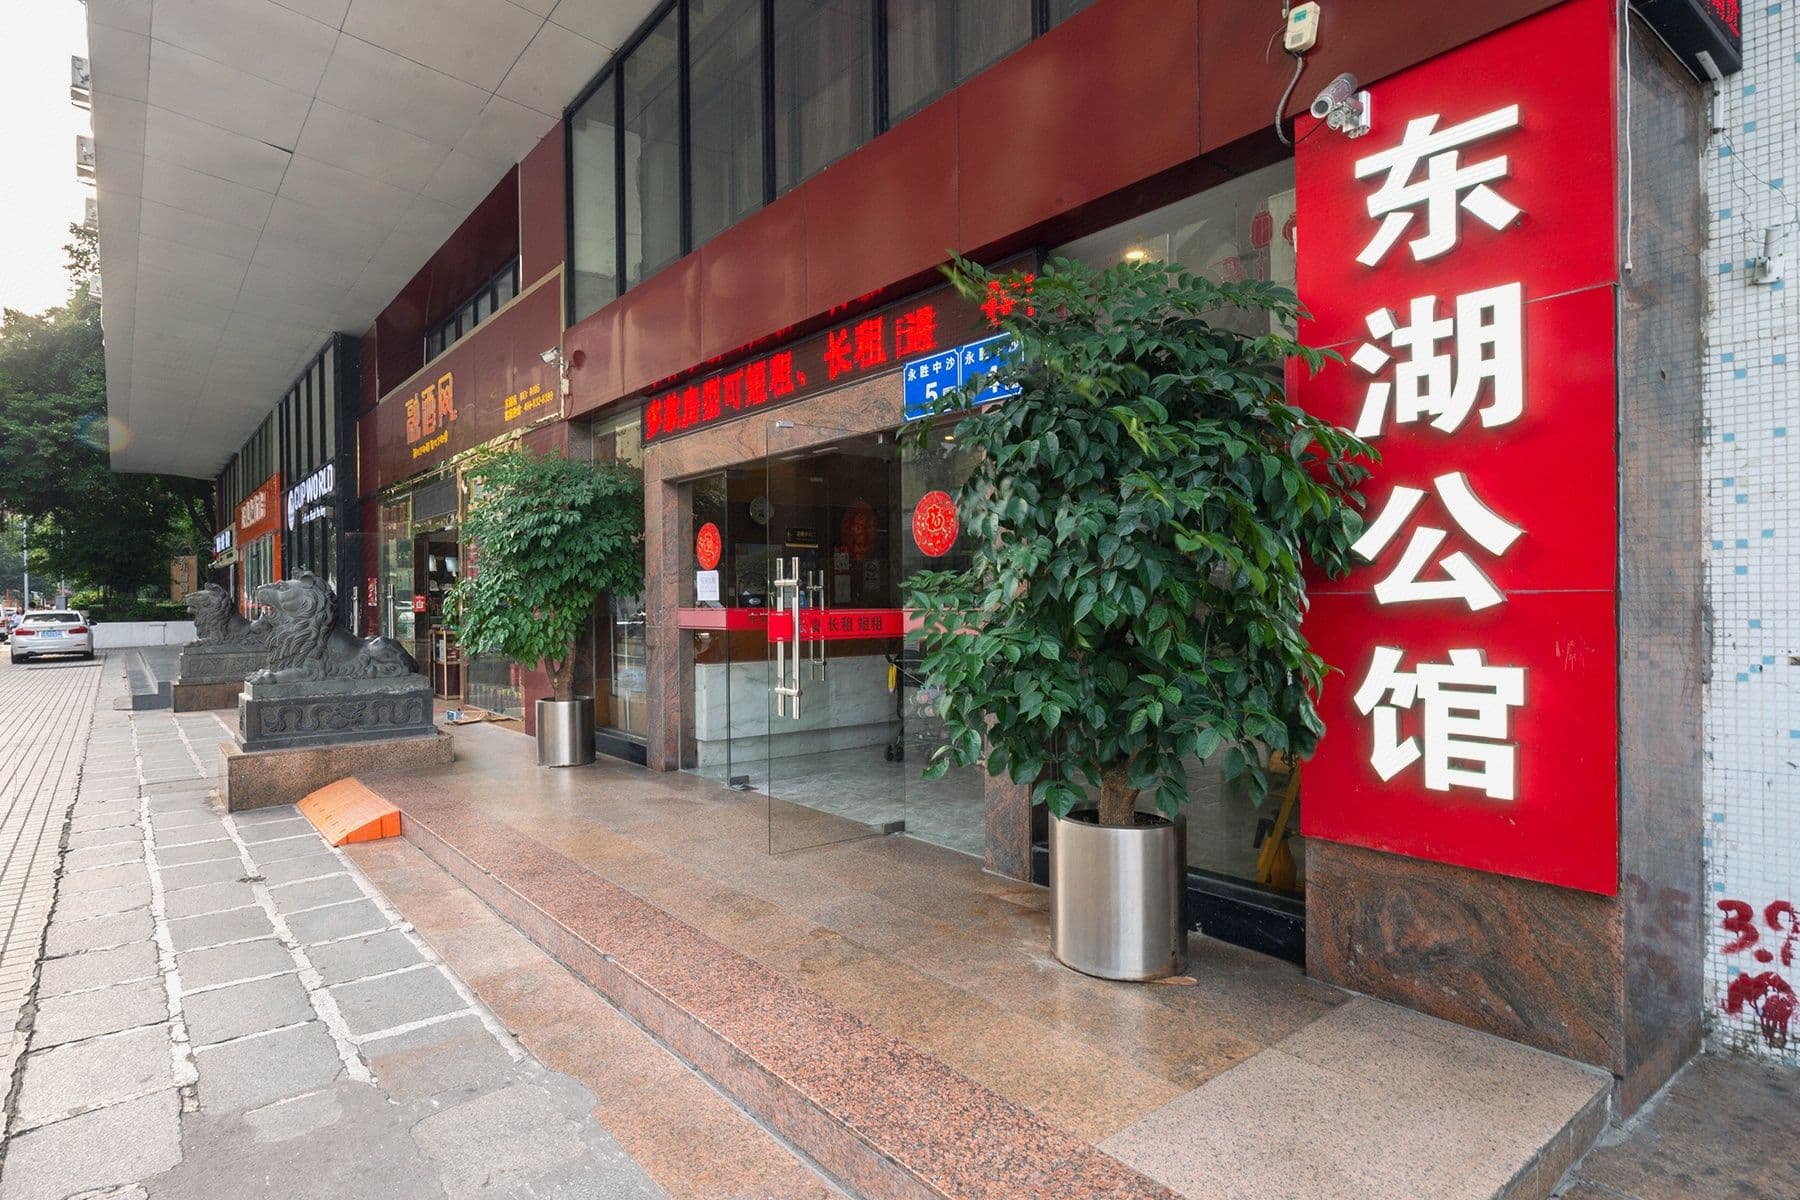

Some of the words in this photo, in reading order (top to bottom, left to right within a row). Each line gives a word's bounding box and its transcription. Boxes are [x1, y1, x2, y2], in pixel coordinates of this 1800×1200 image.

[907, 356, 956, 382] 永胜中沙
[1350, 103, 1528, 801] 东湖公馆
